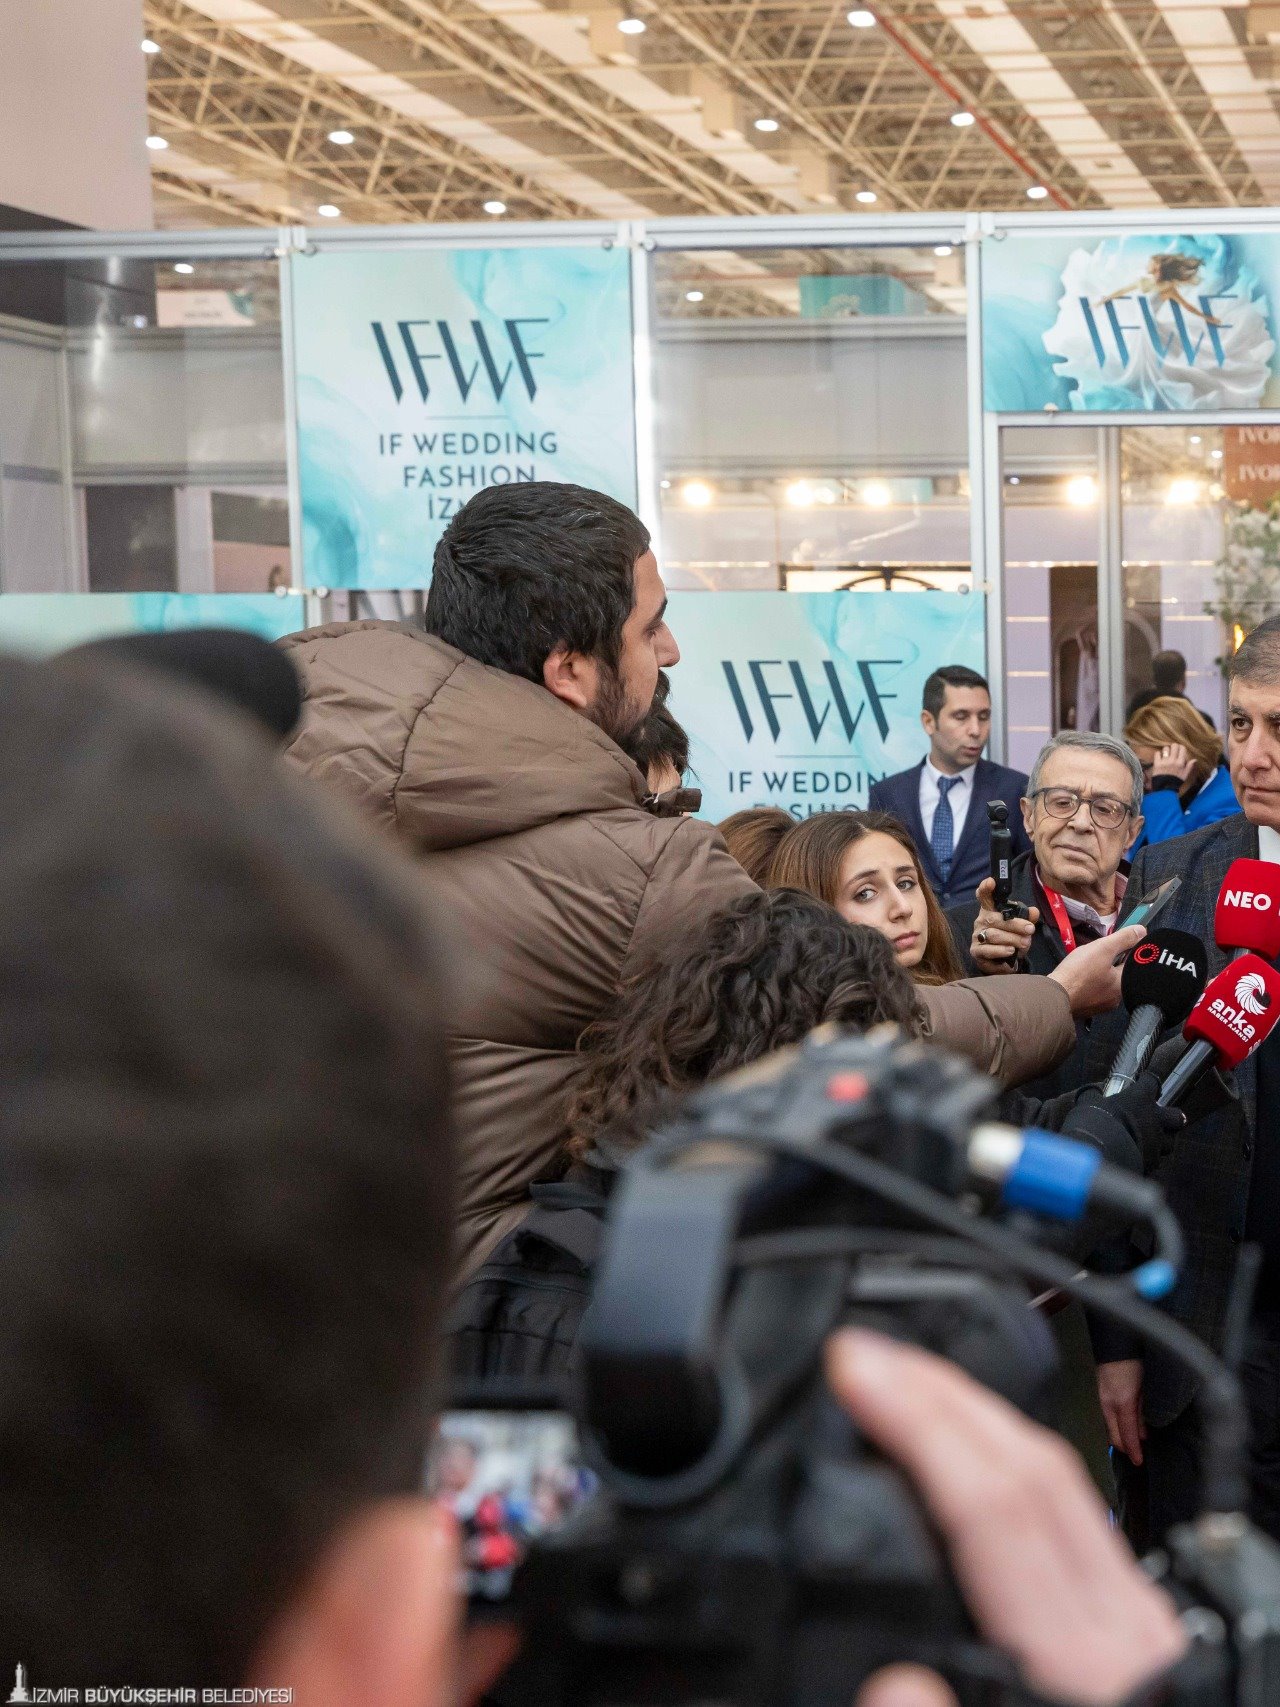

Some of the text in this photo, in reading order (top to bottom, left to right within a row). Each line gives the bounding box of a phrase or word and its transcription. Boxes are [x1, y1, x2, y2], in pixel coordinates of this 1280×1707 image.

[1079, 295, 1238, 369] IFWF
[371, 318, 549, 405] IFWF
[379, 432, 558, 455] IF WEDDING
[403, 465, 536, 488] FASHION
[721, 660, 903, 744] IFWF
[729, 771, 753, 793] IF
[1223, 889, 1272, 911] NEO
[1157, 949, 1198, 979] İHA
[1211, 998, 1256, 1040] anka
